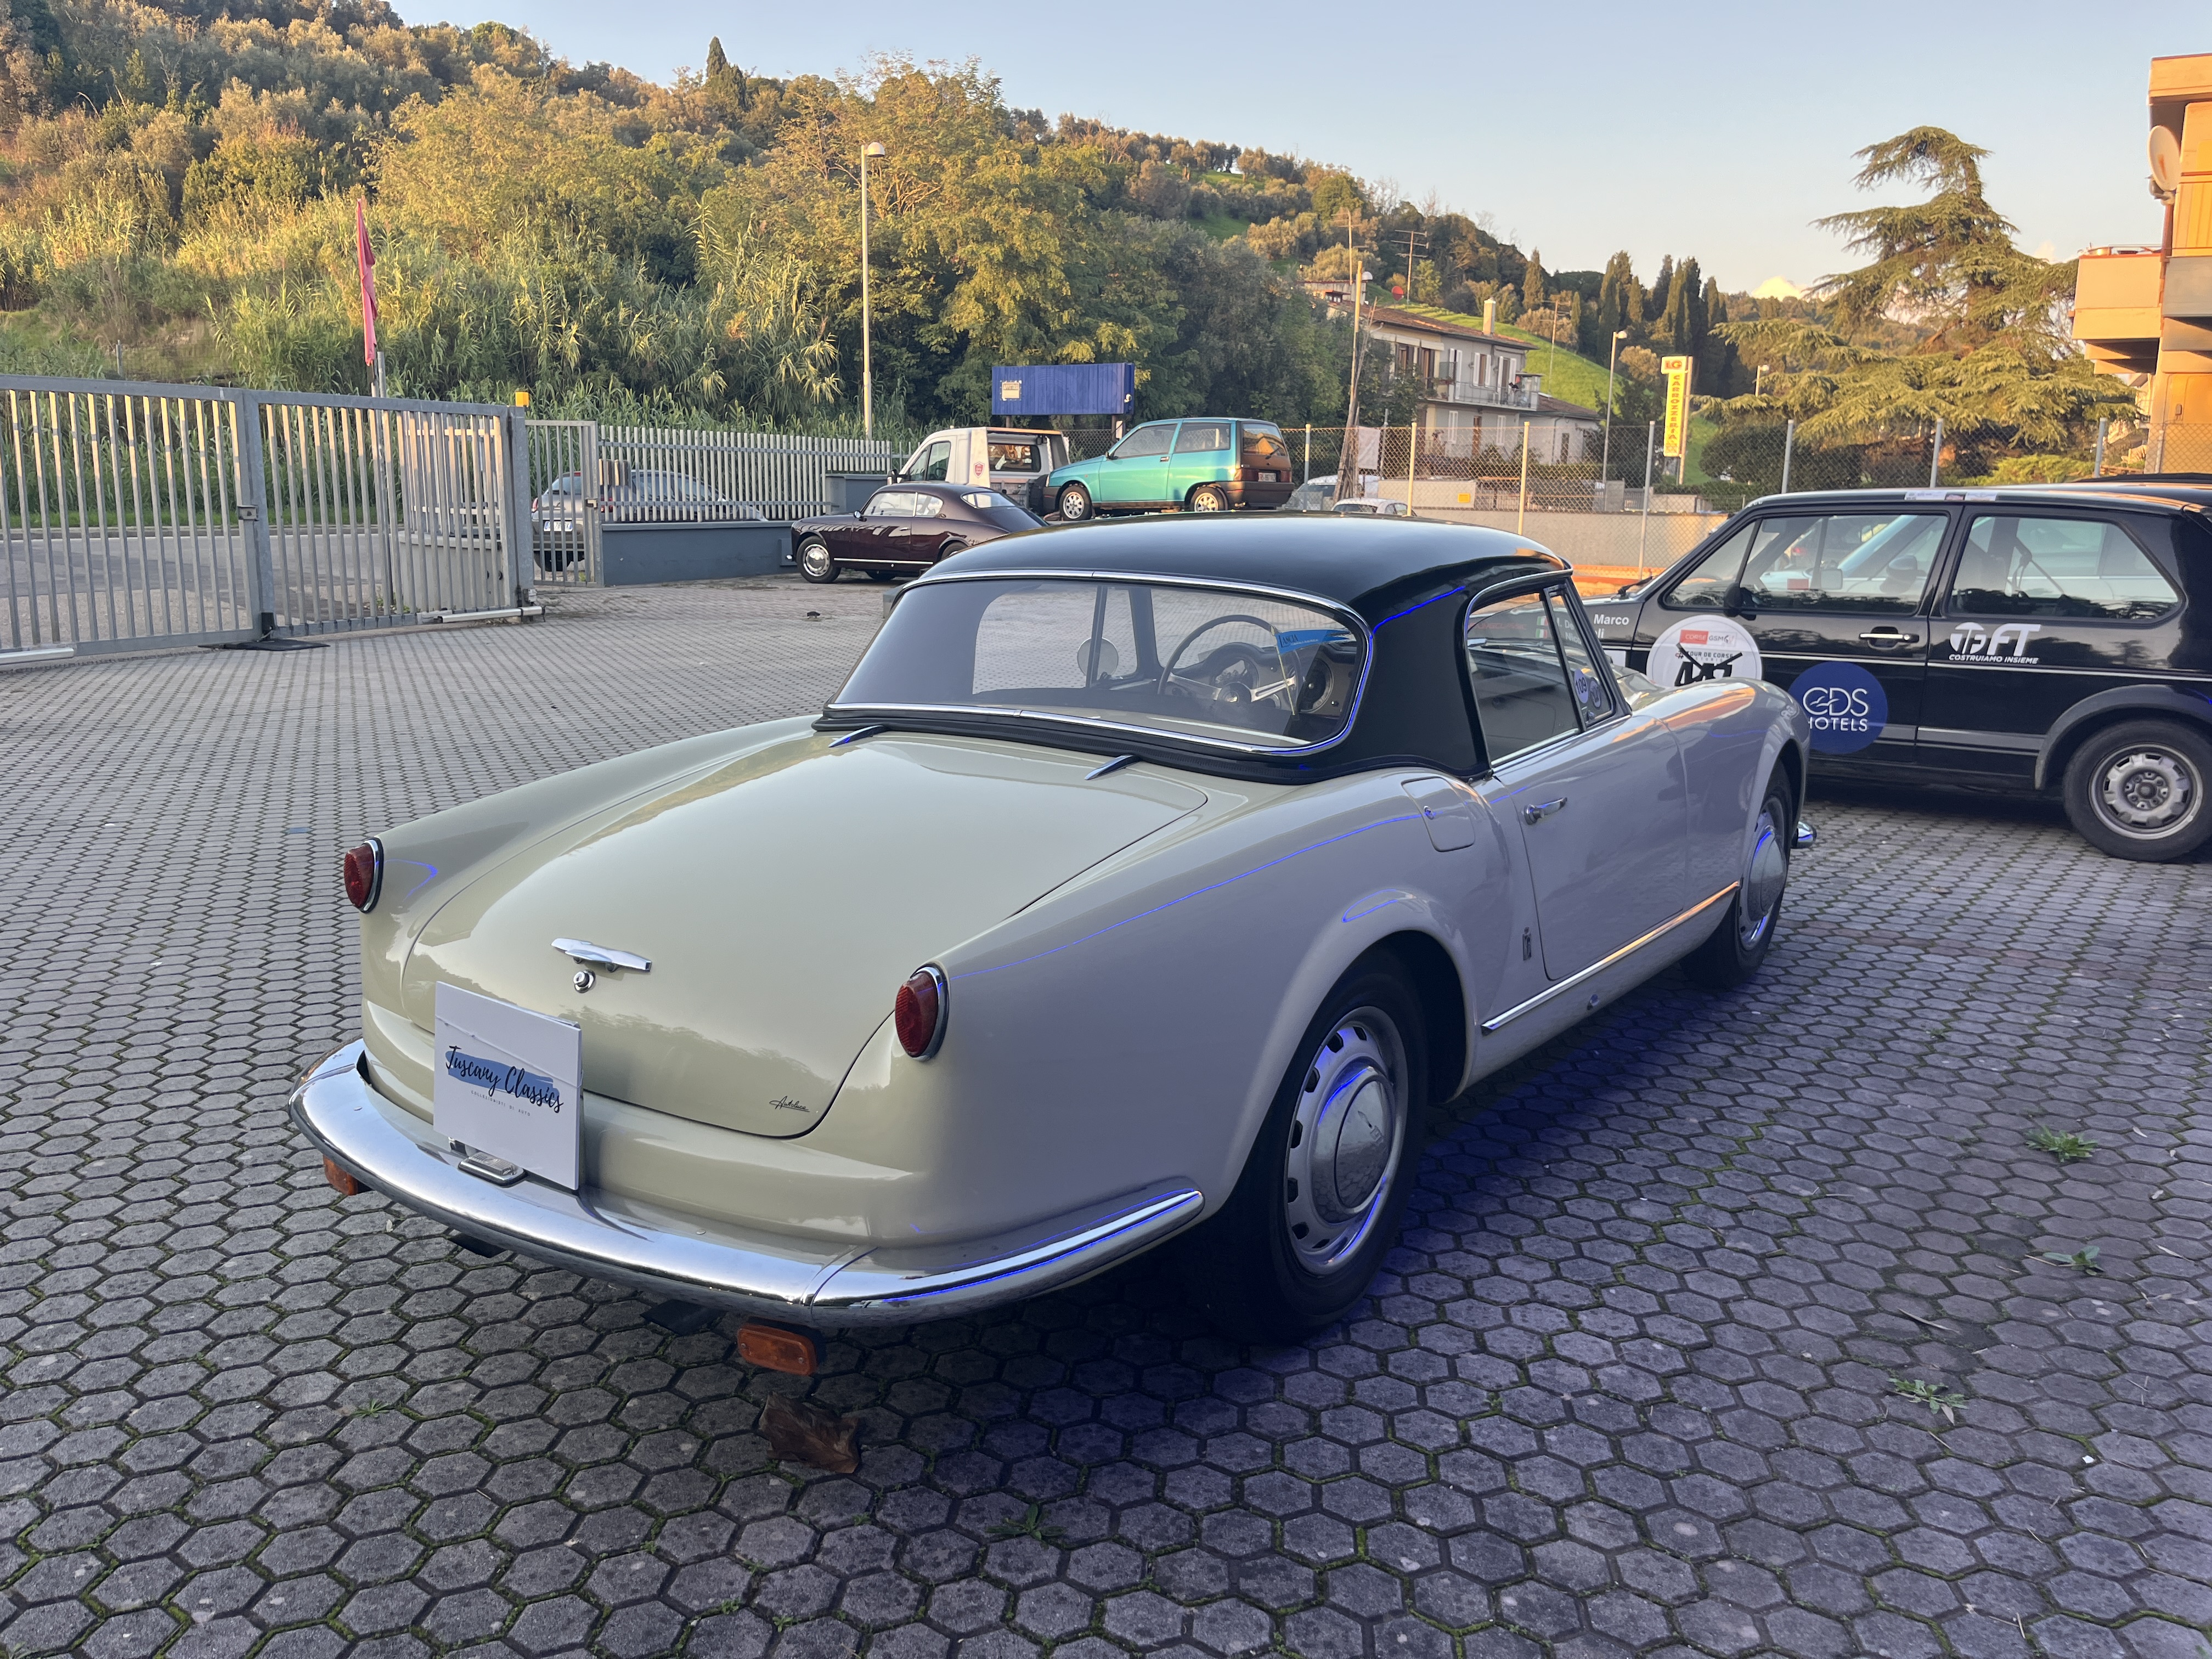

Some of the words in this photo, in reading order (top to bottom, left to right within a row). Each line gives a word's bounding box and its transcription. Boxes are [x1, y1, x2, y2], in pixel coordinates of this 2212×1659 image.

[1668, 375, 1680, 439] CARROZZERIA
[1593, 614, 1630, 625] Marco
[1278, 634, 1299, 648] LANCIA
[1949, 654, 2003, 663] COSTRUIAMO
[2004, 656, 2039, 664] INSIEME
[1576, 676, 1587, 695] 109
[1803, 687, 1869, 717] CDS
[445, 1045, 501, 1097] Tuscany
[505, 1065, 564, 1114] Classics
[471, 1090, 506, 1107] COLLEZIONISTI
[518, 1108, 531, 1116] AUTO
